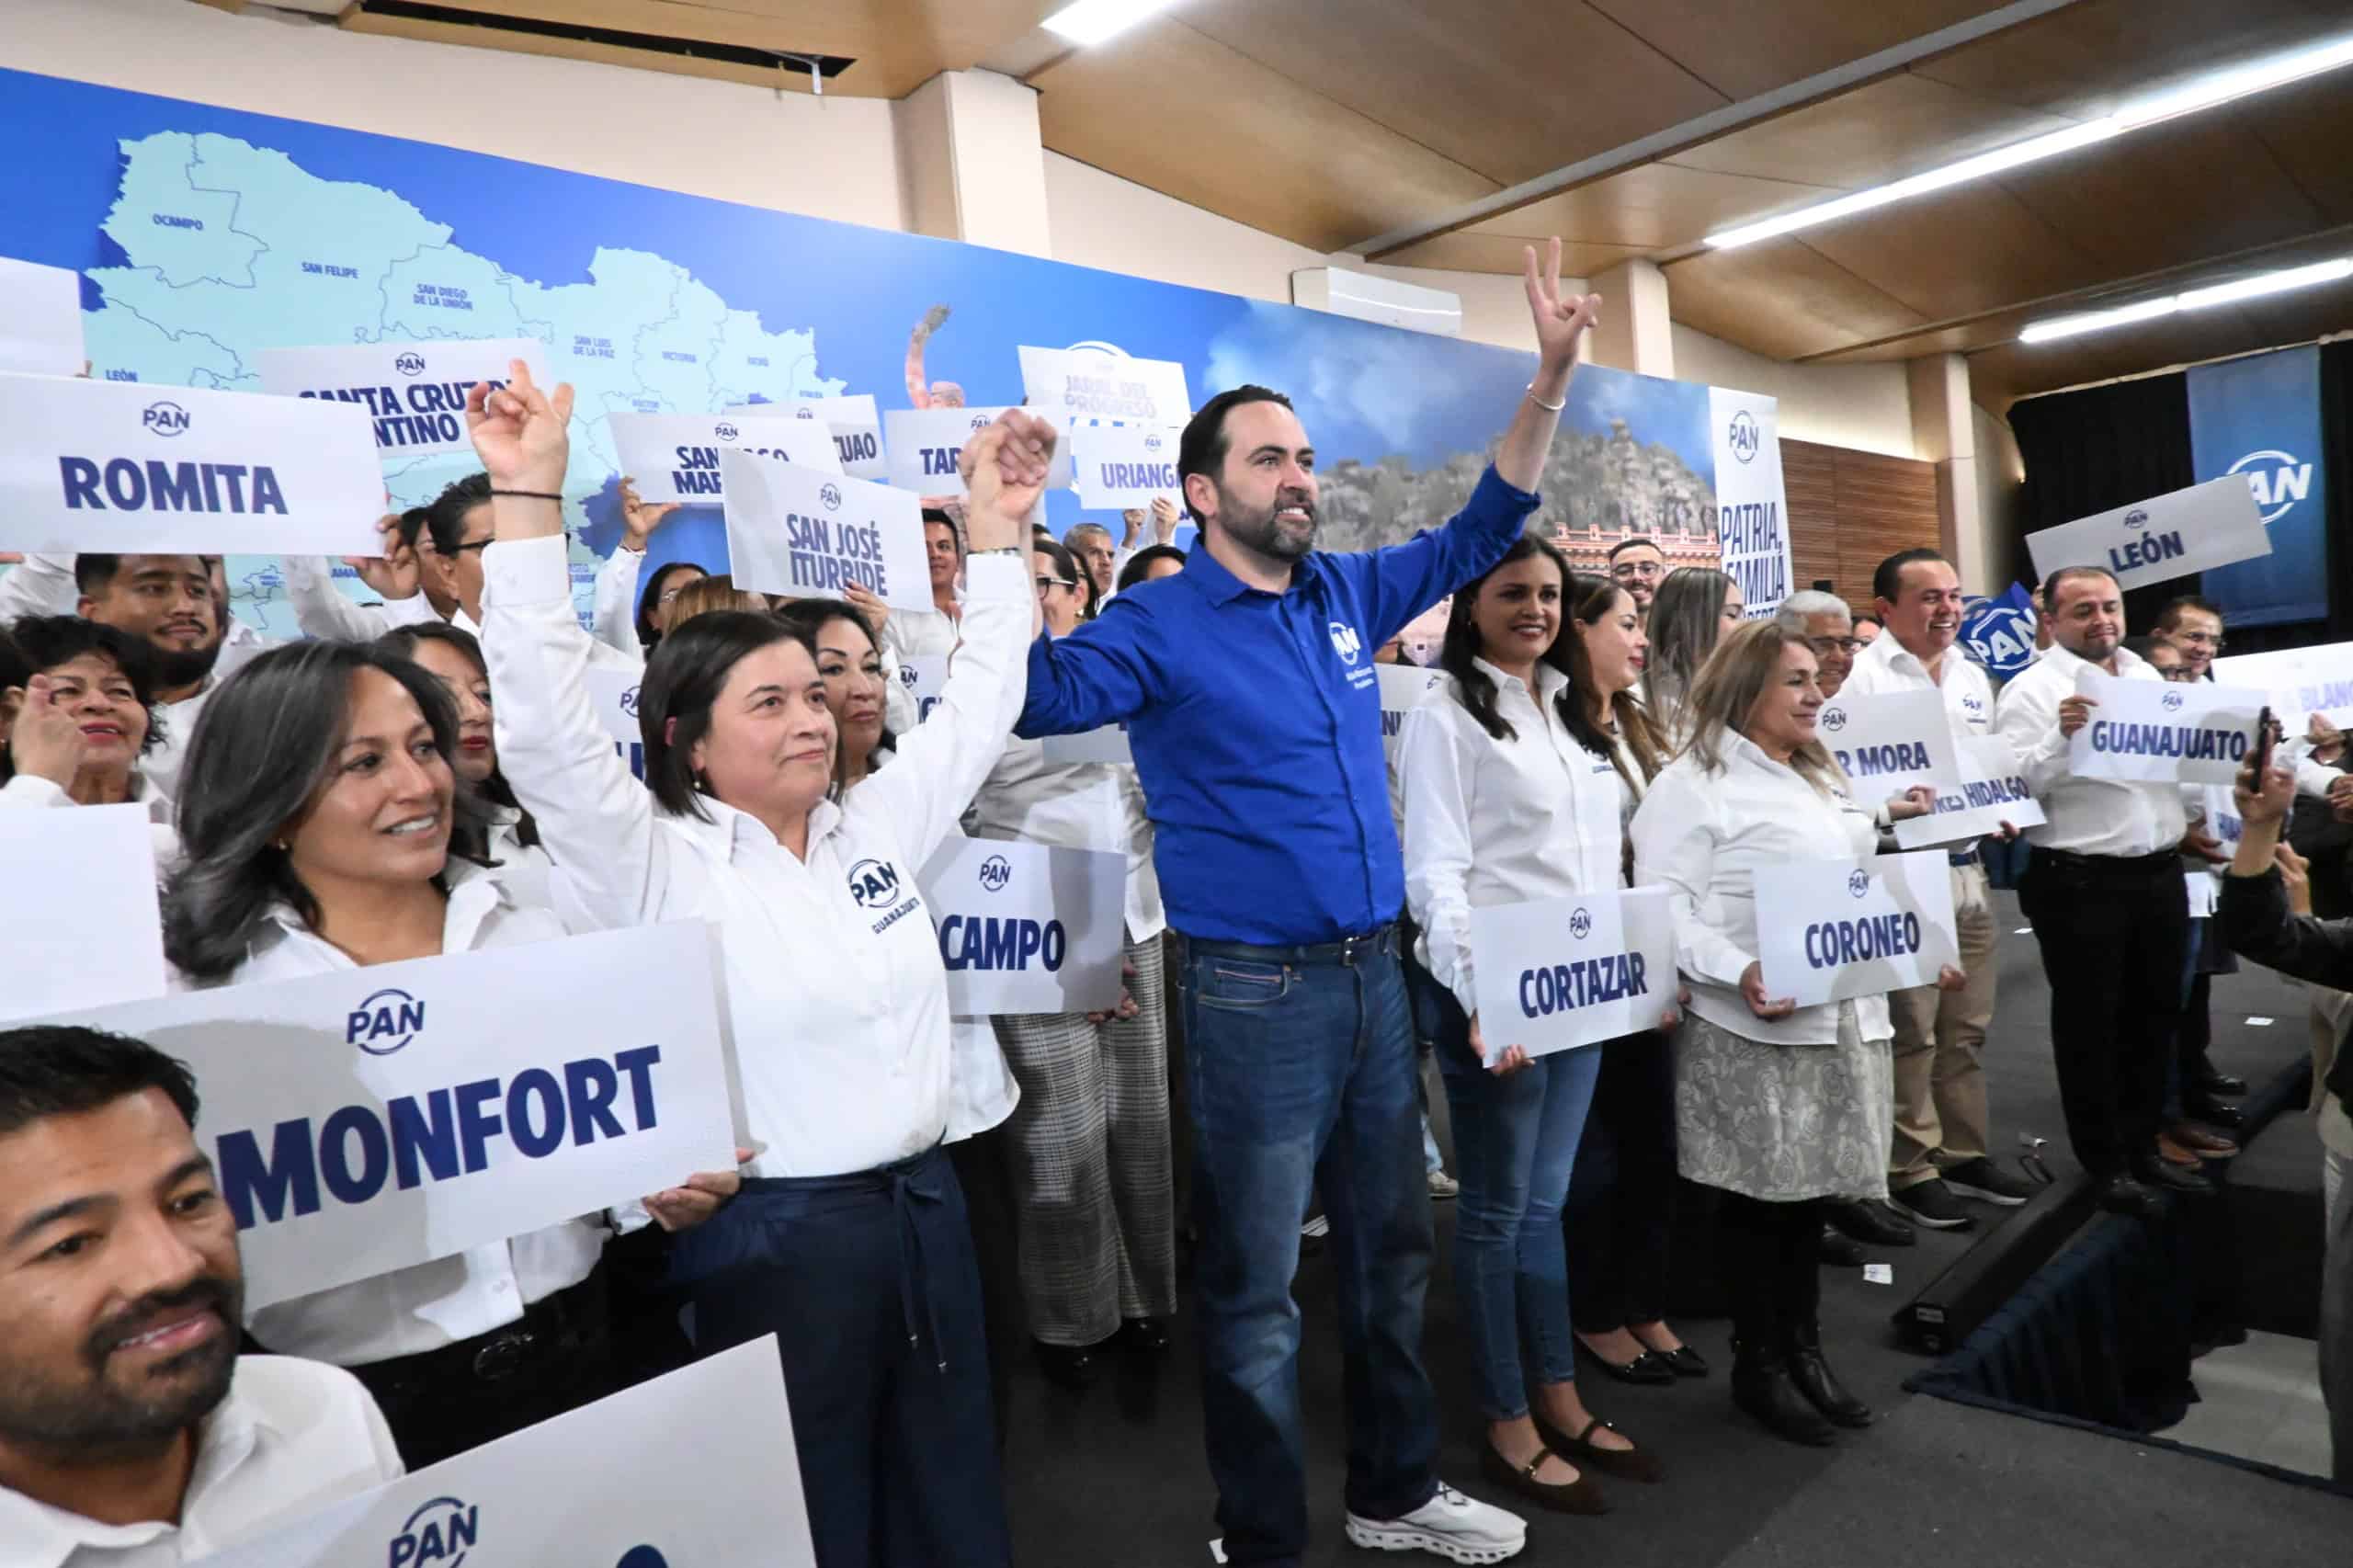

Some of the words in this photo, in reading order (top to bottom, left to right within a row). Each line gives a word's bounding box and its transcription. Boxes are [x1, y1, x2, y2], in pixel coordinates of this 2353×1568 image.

[153, 214, 203, 230] OCAMPO
[301, 262, 323, 275] SAN
[325, 266, 358, 278] FELIPE
[416, 283, 437, 295] SAN
[438, 286, 468, 299] DIEGO
[106, 368, 138, 382] LEÓN
[395, 358, 426, 371] PAN
[142, 409, 191, 429] PAN
[372, 414, 460, 448] NTINO
[714, 426, 738, 437] PAN
[1729, 424, 1758, 450] PAN
[59, 456, 290, 515] ROMITA
[820, 490, 841, 506] PAN
[2247, 463, 2313, 506] AN
[787, 514, 830, 554] SAN
[835, 520, 882, 562] JOSÉ
[1721, 502, 1783, 556] PATRIA,
[2109, 531, 2185, 573] LEÓN
[790, 551, 888, 597] ITURBIDE
[1967, 608, 2038, 664] PAN
[1823, 711, 1847, 727] PAN
[1856, 741, 1933, 777] MORA
[2091, 720, 2246, 762] GUANAJUATO
[1963, 776, 2030, 808] HIDALGO
[850, 861, 900, 907] PAN
[979, 864, 1011, 883] PAN
[1848, 875, 1870, 891] PAN
[1570, 915, 1591, 933] PAN
[1805, 911, 1920, 970] CORONEO
[930, 914, 1066, 972] CAMPO
[1519, 951, 1648, 1018] CORTAZAR
[347, 1000, 426, 1045] PAN
[216, 1044, 662, 1231] MONFORT
[390, 1505, 479, 1568] PAN
